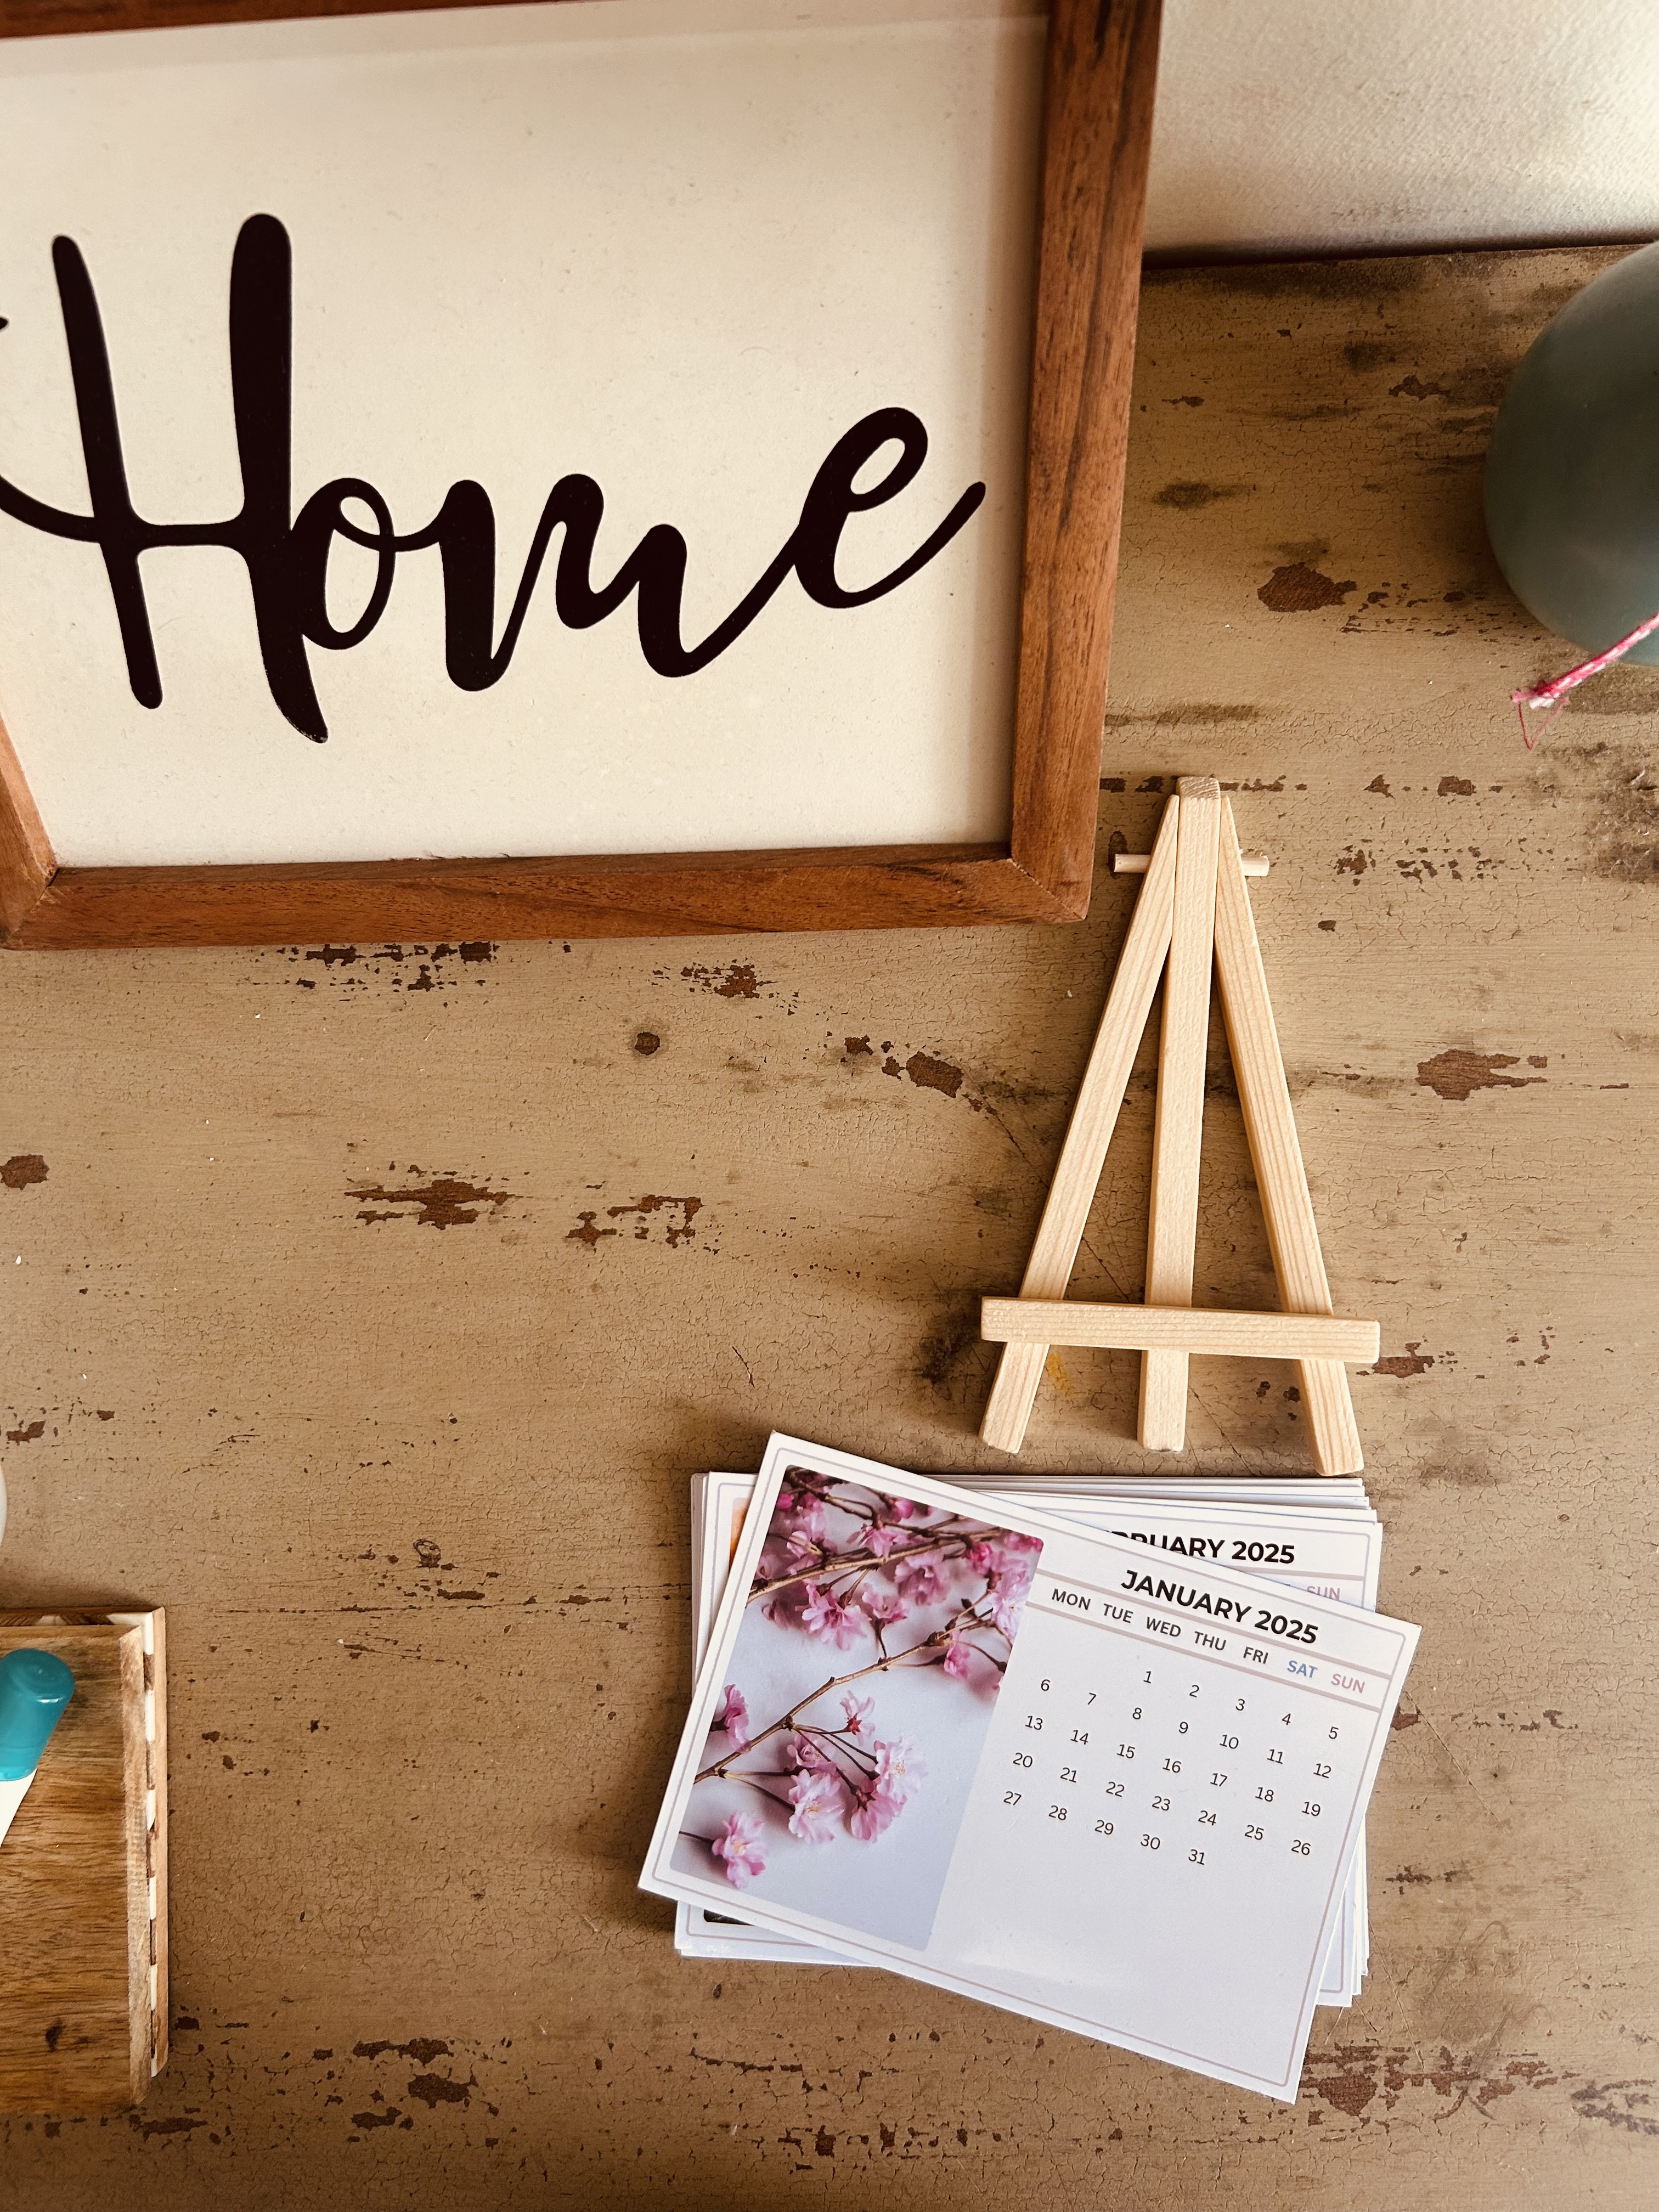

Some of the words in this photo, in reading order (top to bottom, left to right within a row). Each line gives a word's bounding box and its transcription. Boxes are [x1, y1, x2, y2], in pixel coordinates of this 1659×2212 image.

[0, 213, 986, 744] Home
[1231, 1540, 1295, 1564] 2025
[1051, 1588, 1091, 1611] MON
[1103, 1603, 1134, 1624] TUE
[1146, 1616, 1182, 1638] WED
[1194, 1630, 1227, 1651] THU
[1243, 1646, 1269, 1665] FRI
[1286, 1659, 1318, 1679] SAT
[1330, 1673, 1366, 1695] SUN
[1120, 1569, 1252, 1623] JANUARY
[1254, 1610, 1319, 1644] 2025
[1041, 1679, 1051, 1692] 6
[1087, 1692, 1097, 1705] 7
[1132, 1707, 1142, 1720] 8
[1178, 1721, 1189, 1734] 9
[1219, 1734, 1239, 1750] 10
[1266, 1748, 1284, 1764] 11
[1313, 1763, 1331, 1779] 12
[1143, 1671, 1152, 1684] 1
[1189, 1684, 1200, 1698] 2
[1235, 1698, 1245, 1711] 3
[1281, 1713, 1291, 1726] 4
[1328, 1726, 1339, 1740] 5
[1012, 1752, 1033, 1768] 20
[1060, 1767, 1077, 1784] 21
[1105, 1781, 1125, 1798] 22
[1152, 1796, 1171, 1812] 23
[1198, 1810, 1217, 1826] 24
[1244, 1824, 1265, 1841] 25
[1291, 1839, 1311, 1855] 26
[1024, 1716, 1043, 1731] 13
[1070, 1729, 1089, 1745] 14
[1116, 1743, 1136, 1759] 15
[1162, 1758, 1182, 1774] 16
[1210, 1773, 1228, 1788] 17
[1255, 1786, 1274, 1802] 18
[1301, 1801, 1321, 1817] 19
[1003, 1791, 1022, 1806] 27
[1048, 1805, 1068, 1821] 28
[1094, 1819, 1114, 1836] 29
[1140, 1833, 1161, 1850] 30
[1188, 1849, 1206, 1866] 31
